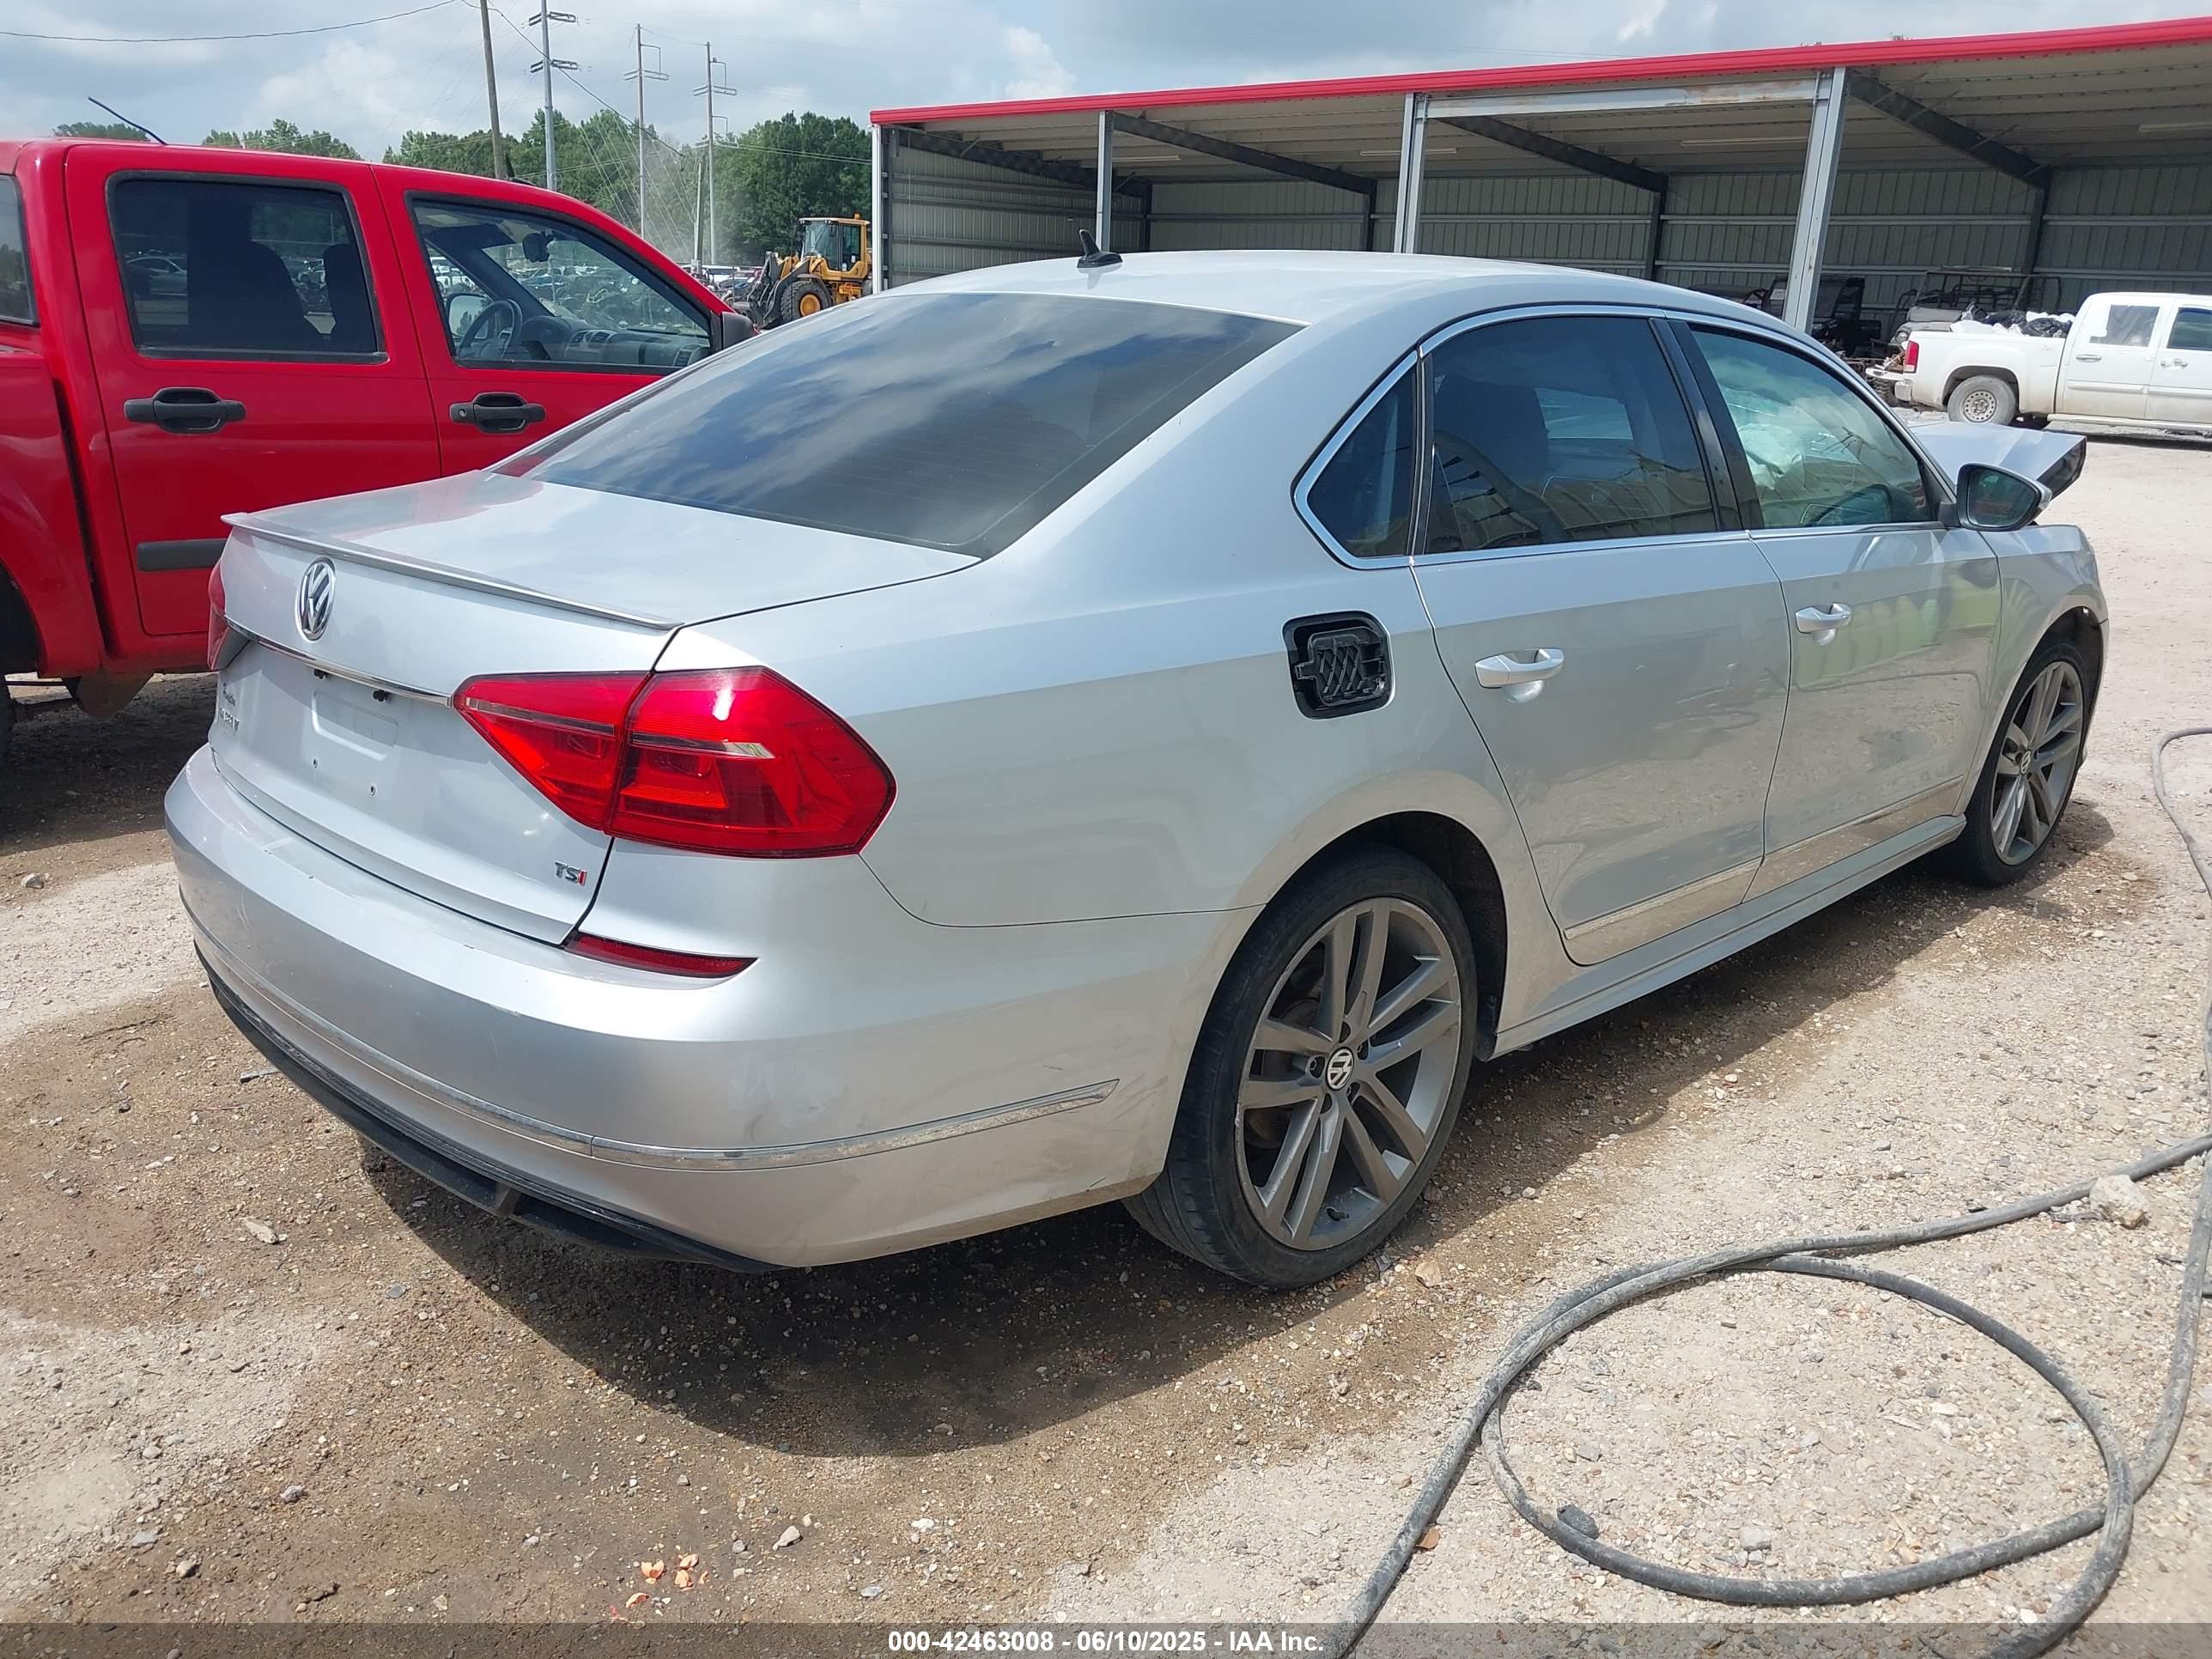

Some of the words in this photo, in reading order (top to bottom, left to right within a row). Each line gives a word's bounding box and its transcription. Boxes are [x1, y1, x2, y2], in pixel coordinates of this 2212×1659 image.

[298, 558, 335, 641] VW
[555, 860, 587, 886] TSI
[1327, 1048, 1353, 1090] VW
